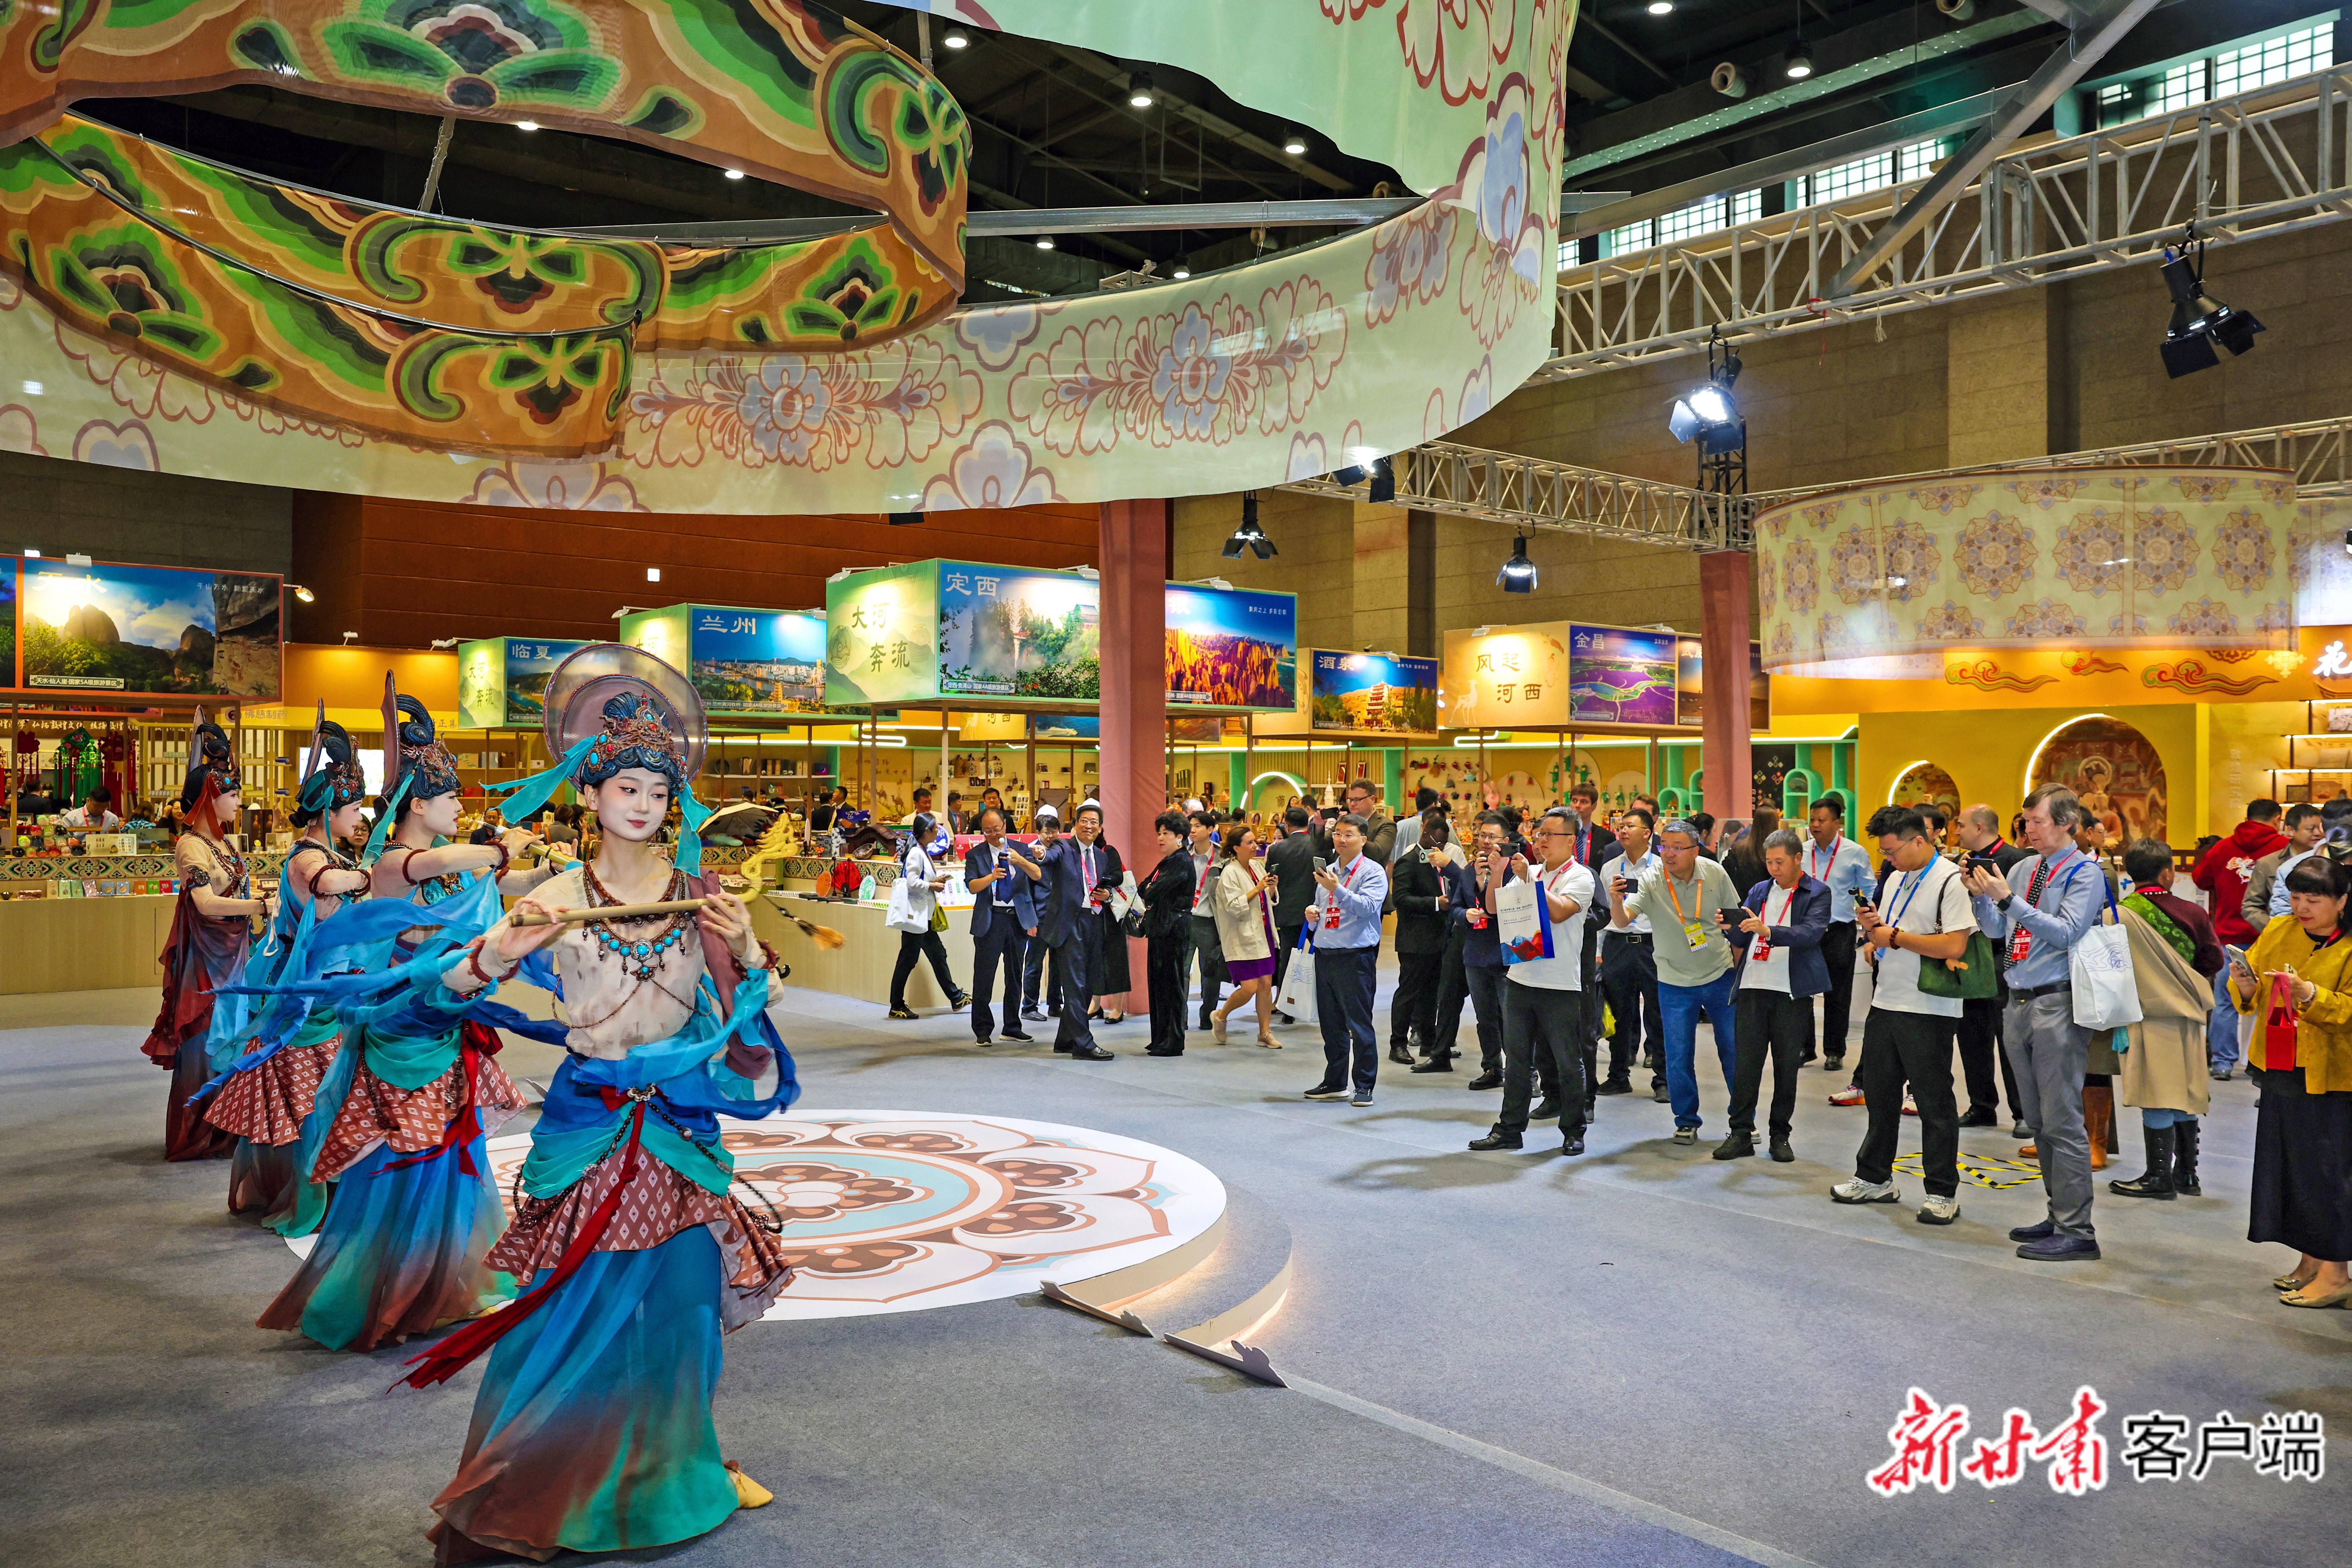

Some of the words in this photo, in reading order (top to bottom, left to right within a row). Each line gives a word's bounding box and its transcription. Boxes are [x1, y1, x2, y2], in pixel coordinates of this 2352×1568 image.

[31, 571, 107, 595] 天水
[197, 583, 228, 591] 千山万水
[945, 572, 1000, 597] 定西
[699, 615, 756, 635] 兰州
[852, 603, 889, 629] 大河
[1575, 632, 1604, 650] 金昌
[512, 644, 553, 660] 临夏
[870, 640, 909, 673] 奔流
[469, 662, 485, 679] 大河
[1318, 656, 1355, 671] 酒泉
[1476, 652, 1521, 672] 风起
[477, 688, 494, 708] 奔流
[1497, 684, 1542, 703] 河西
[245, 709, 287, 719] 佛慈制药
